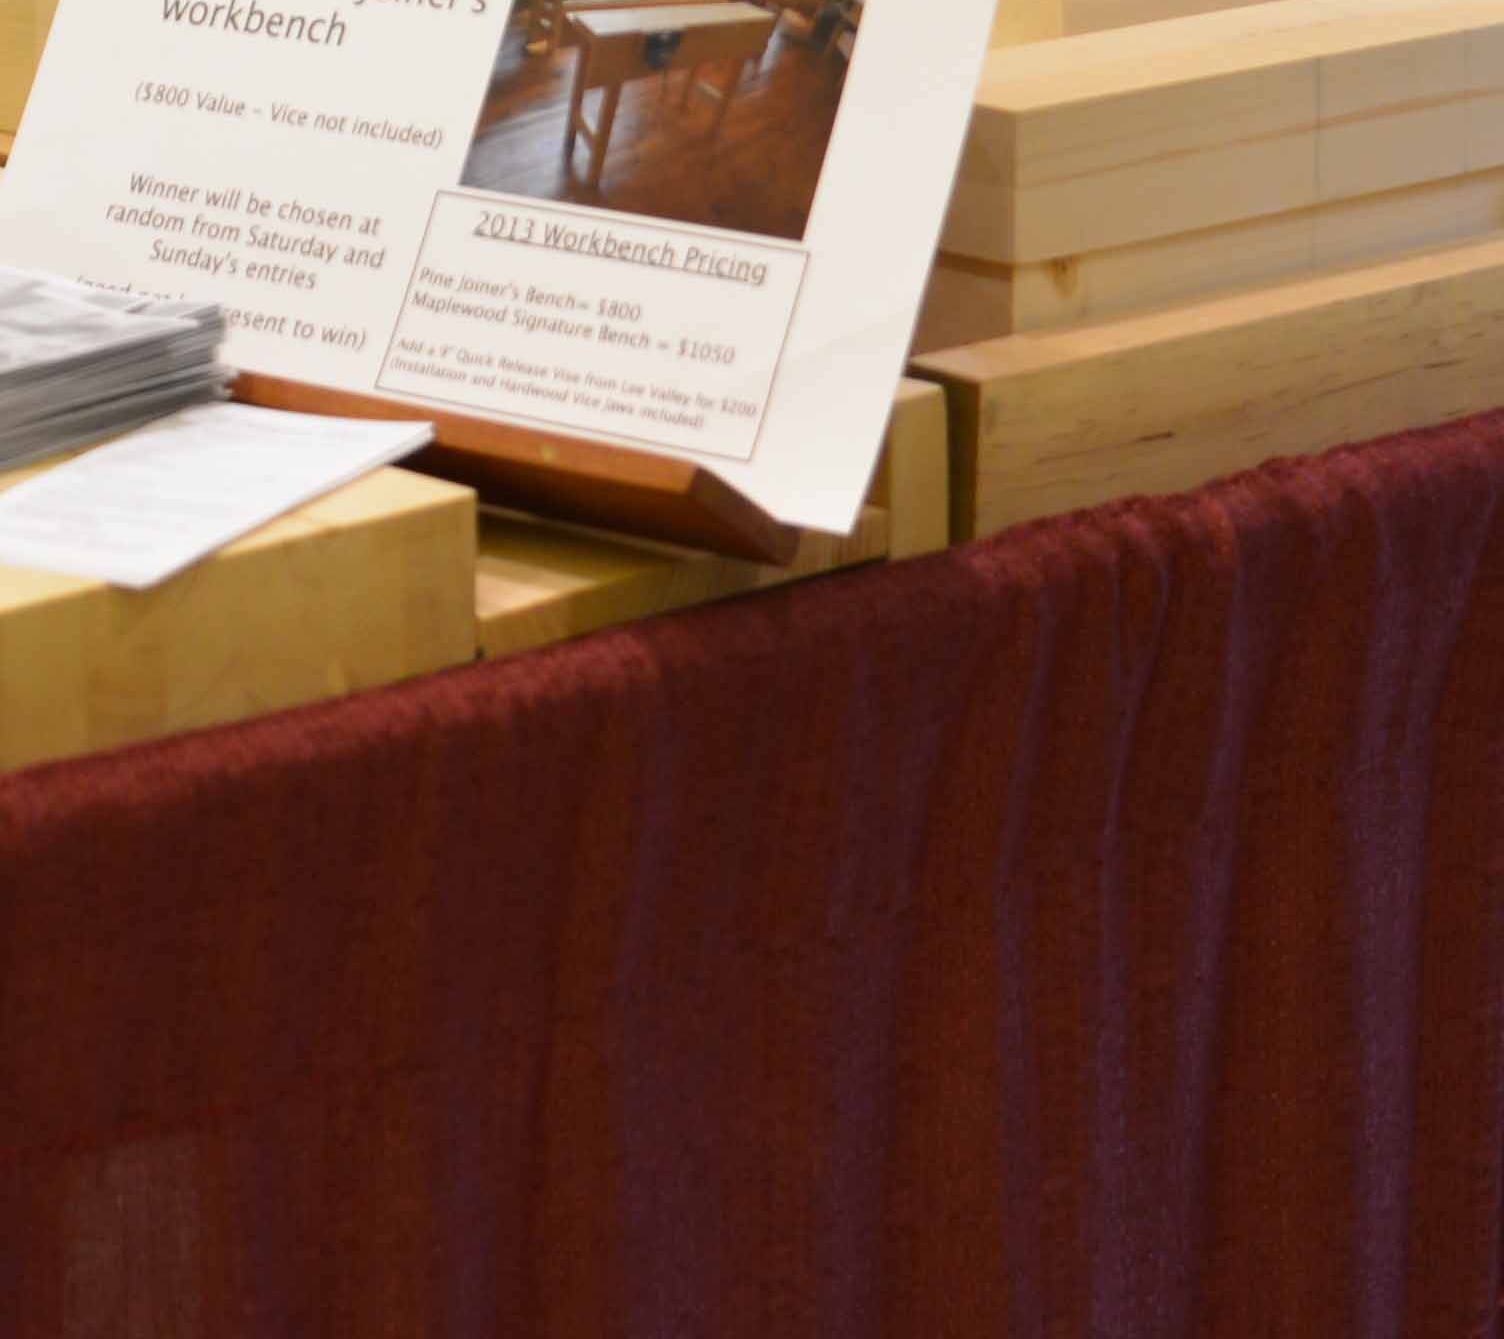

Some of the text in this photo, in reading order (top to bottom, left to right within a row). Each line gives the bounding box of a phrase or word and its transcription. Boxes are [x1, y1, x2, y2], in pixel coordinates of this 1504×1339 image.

[135, 81, 190, 107] ($800
[195, 90, 245, 118] Value
[270, 102, 309, 127] Vice
[313, 113, 348, 133] not
[351, 116, 444, 151] included)
[105, 202, 388, 269] random from Saturday and
[128, 172, 382, 237] Winner will be chosen at
[149, 239, 318, 290] Sunday's entries
[473, 210, 768, 286] 2013 Workbench Pricing
[419, 266, 454, 285] Pine
[597, 298, 641, 322] $800
[222, 304, 367, 351] resent to win)
[411, 291, 508, 324] Maplewood
[512, 308, 593, 338] Signature
[598, 323, 650, 349] Bench
[676, 338, 736, 365] $1050
